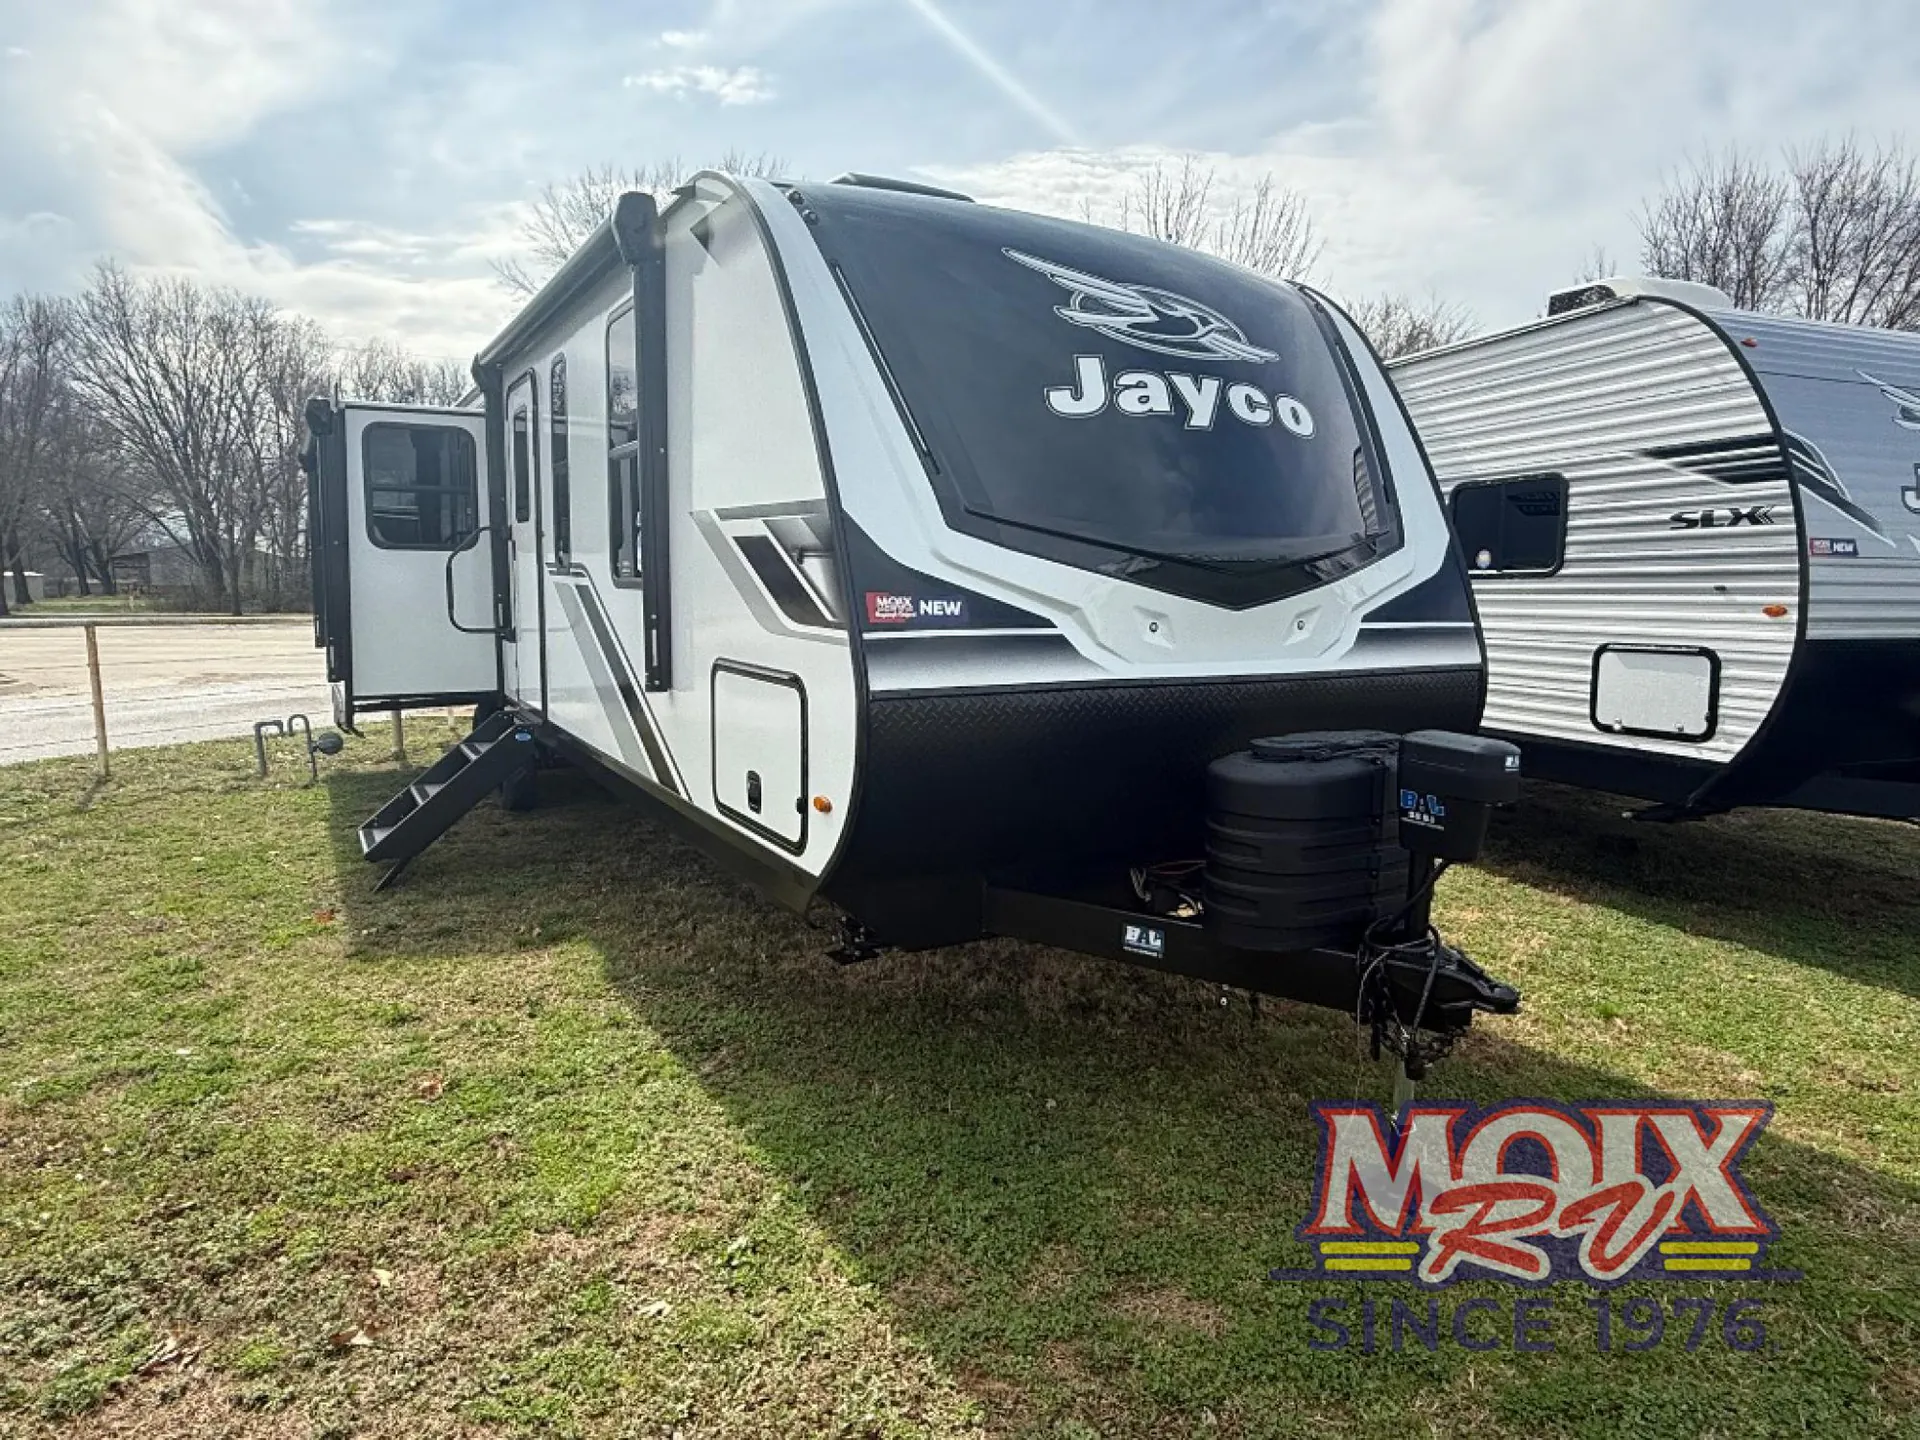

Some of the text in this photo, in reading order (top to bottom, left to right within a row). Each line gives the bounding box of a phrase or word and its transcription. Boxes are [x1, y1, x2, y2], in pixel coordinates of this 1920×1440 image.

[1045, 354, 1316, 439] Jayco
[1669, 506, 1774, 529] SLX
[919, 599, 962, 616] NEW
